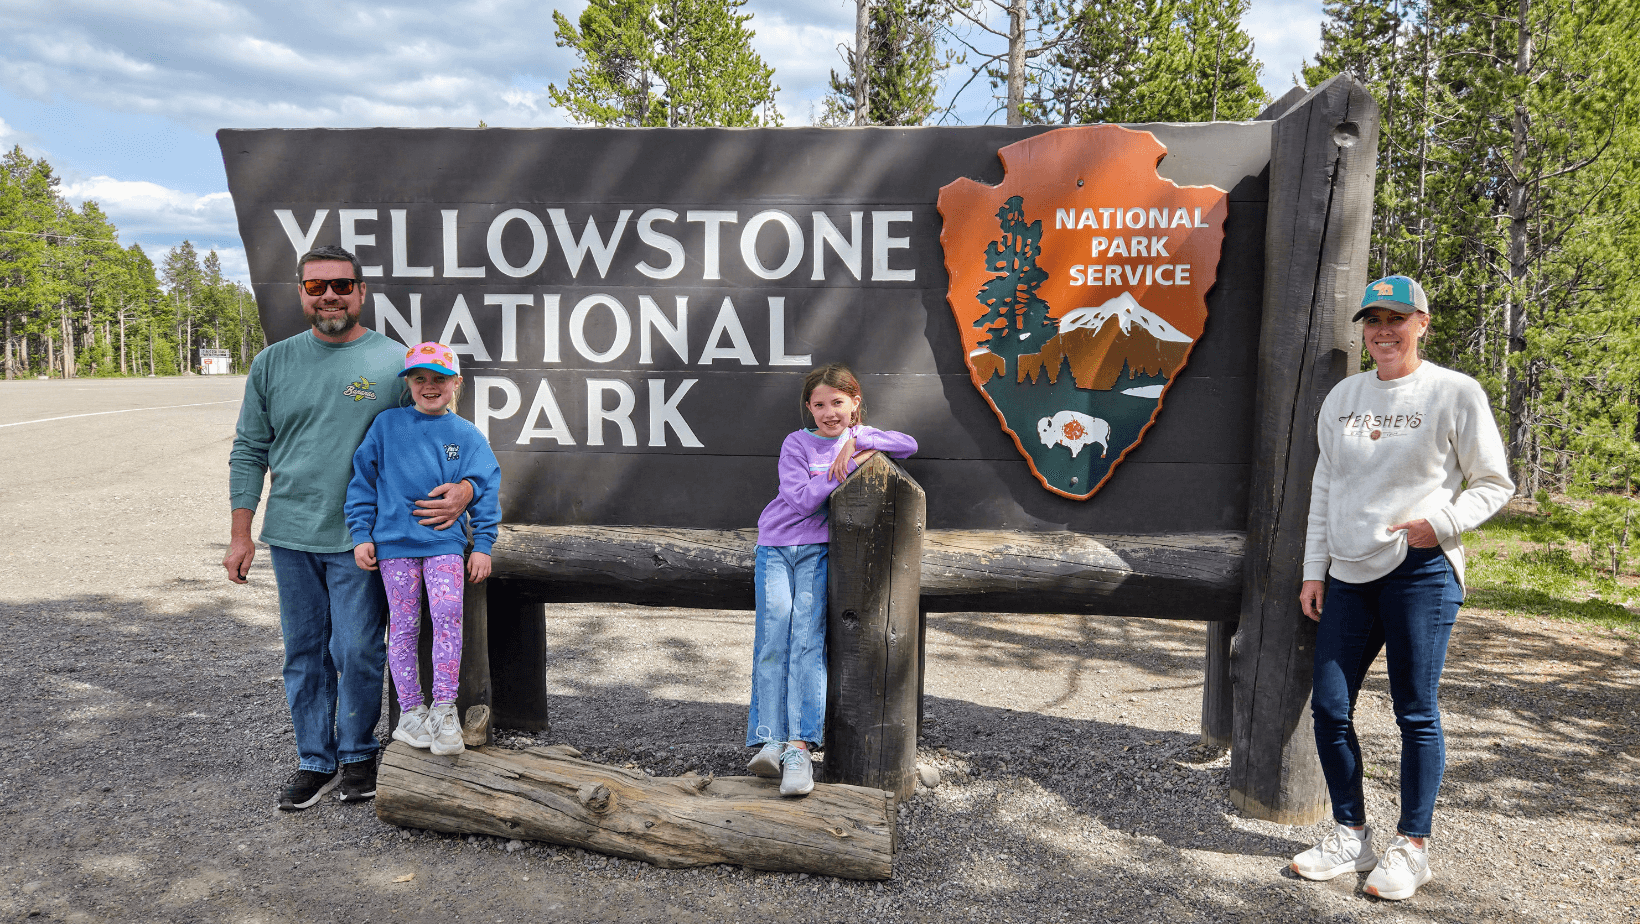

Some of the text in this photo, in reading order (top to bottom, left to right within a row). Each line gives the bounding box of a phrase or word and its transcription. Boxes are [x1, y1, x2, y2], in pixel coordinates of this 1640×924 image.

[1055, 207, 1209, 229] NATIONAL
[274, 208, 915, 281] YELLOWSTONE
[1091, 236, 1170, 257] PARK
[1069, 264, 1191, 286] SERVICE
[374, 293, 812, 365] NATIONAL
[474, 376, 705, 447] PARK
